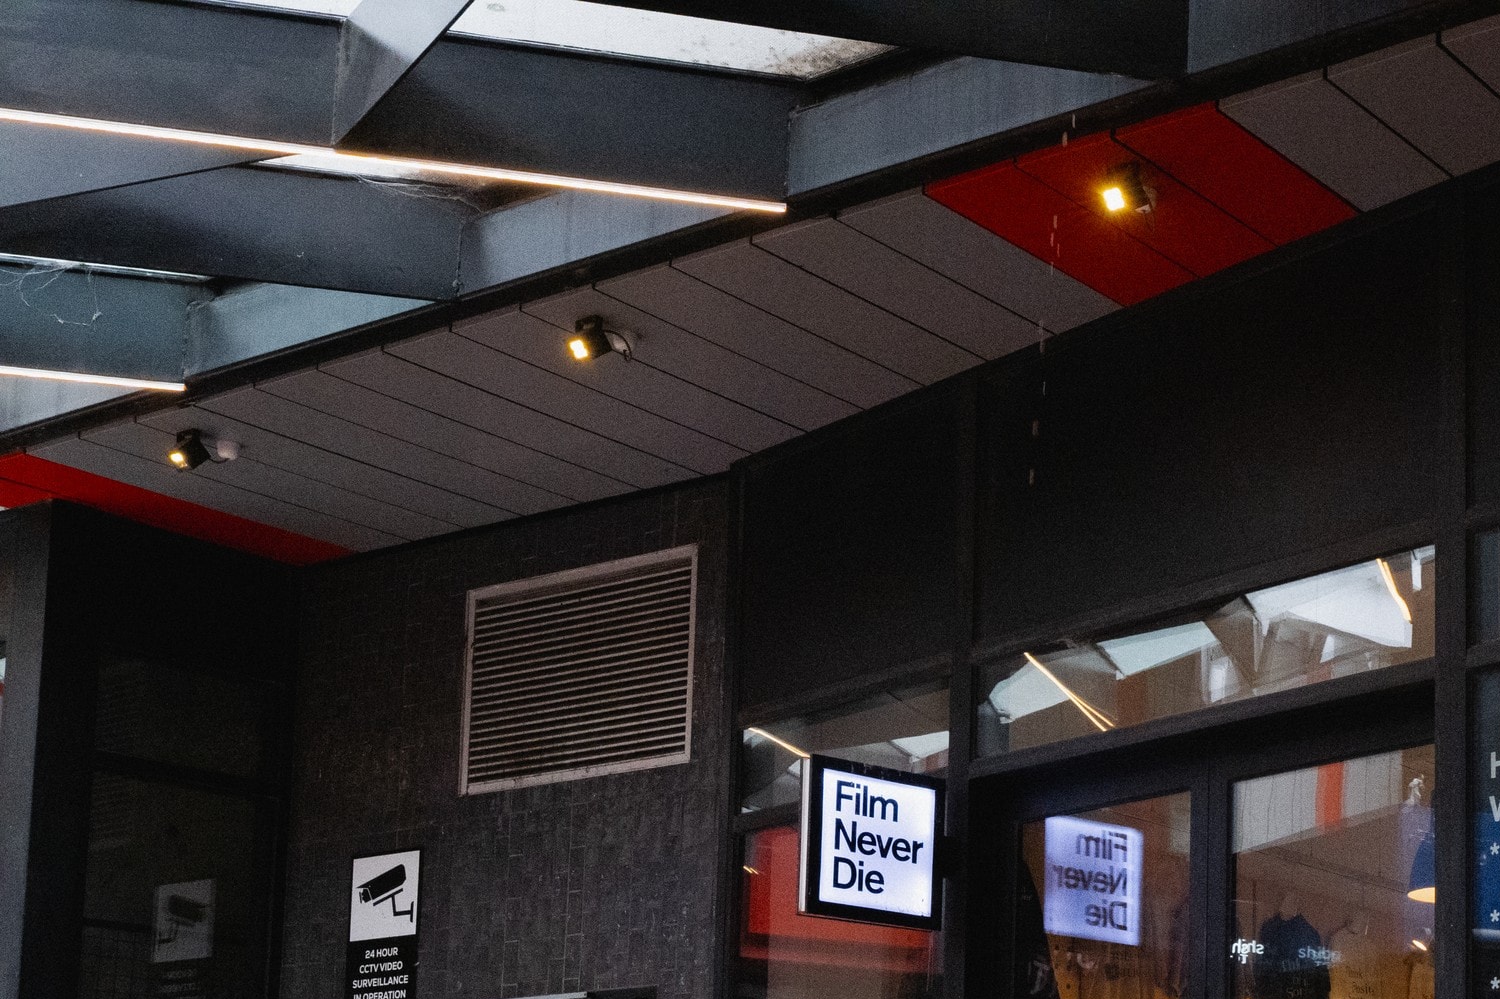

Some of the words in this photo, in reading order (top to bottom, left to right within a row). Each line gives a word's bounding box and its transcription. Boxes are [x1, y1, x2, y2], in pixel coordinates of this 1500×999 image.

[835, 780, 899, 822] Film
[834, 818, 924, 864] Never
[832, 857, 885, 894] Die
[365, 949, 375, 959] 24
[376, 947, 398, 958] HOUR
[359, 963, 379, 974] CCTV
[380, 961, 403, 972] VIDEO
[352, 974, 409, 988] SURVEILLANCE
